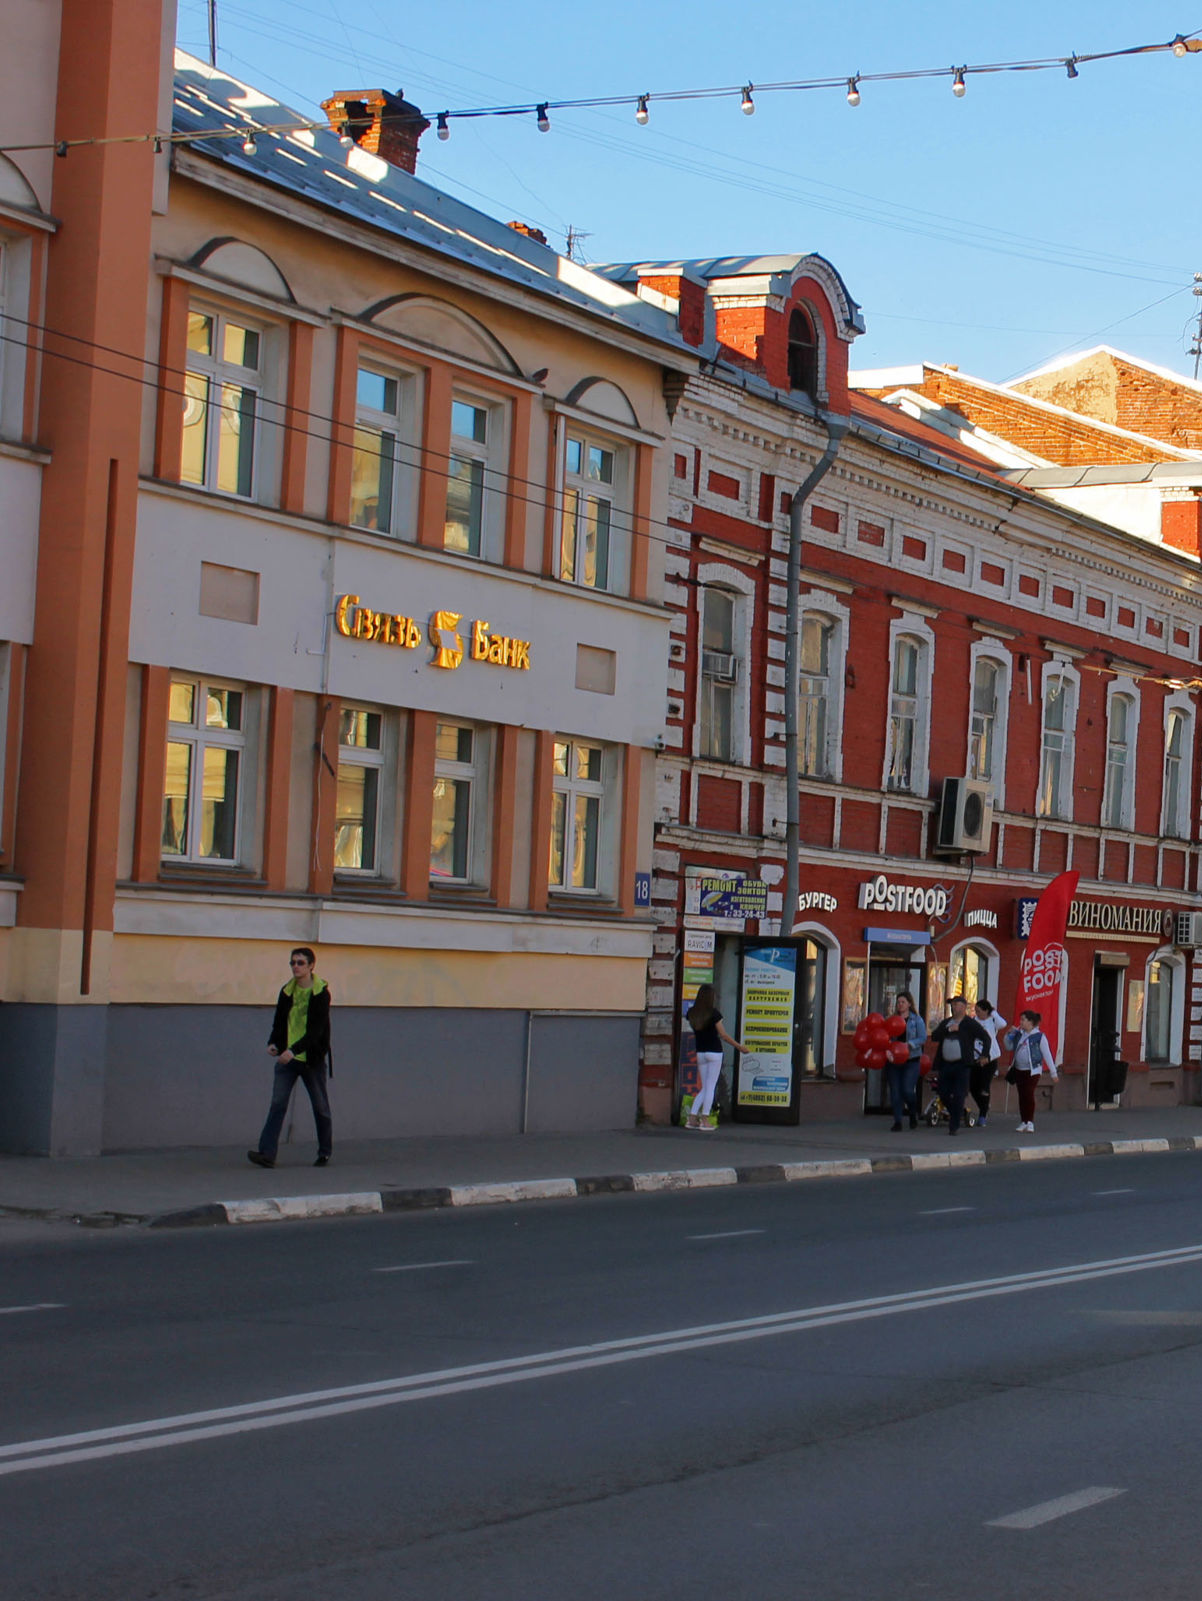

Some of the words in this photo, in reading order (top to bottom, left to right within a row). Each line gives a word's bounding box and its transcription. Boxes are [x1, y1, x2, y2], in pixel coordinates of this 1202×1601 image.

[335, 594, 422, 649] Связь
[471, 620, 532, 670] Банк
[635, 880, 649, 900] 18
[702, 879, 738, 893] РЕМОНТ
[737, 887, 767, 896] ЗОНТОВ
[798, 891, 838, 913] БУРГЕР
[965, 908, 998, 929] ПИЦЦА
[1067, 900, 1162, 934] ВИНОМАНИЯ
